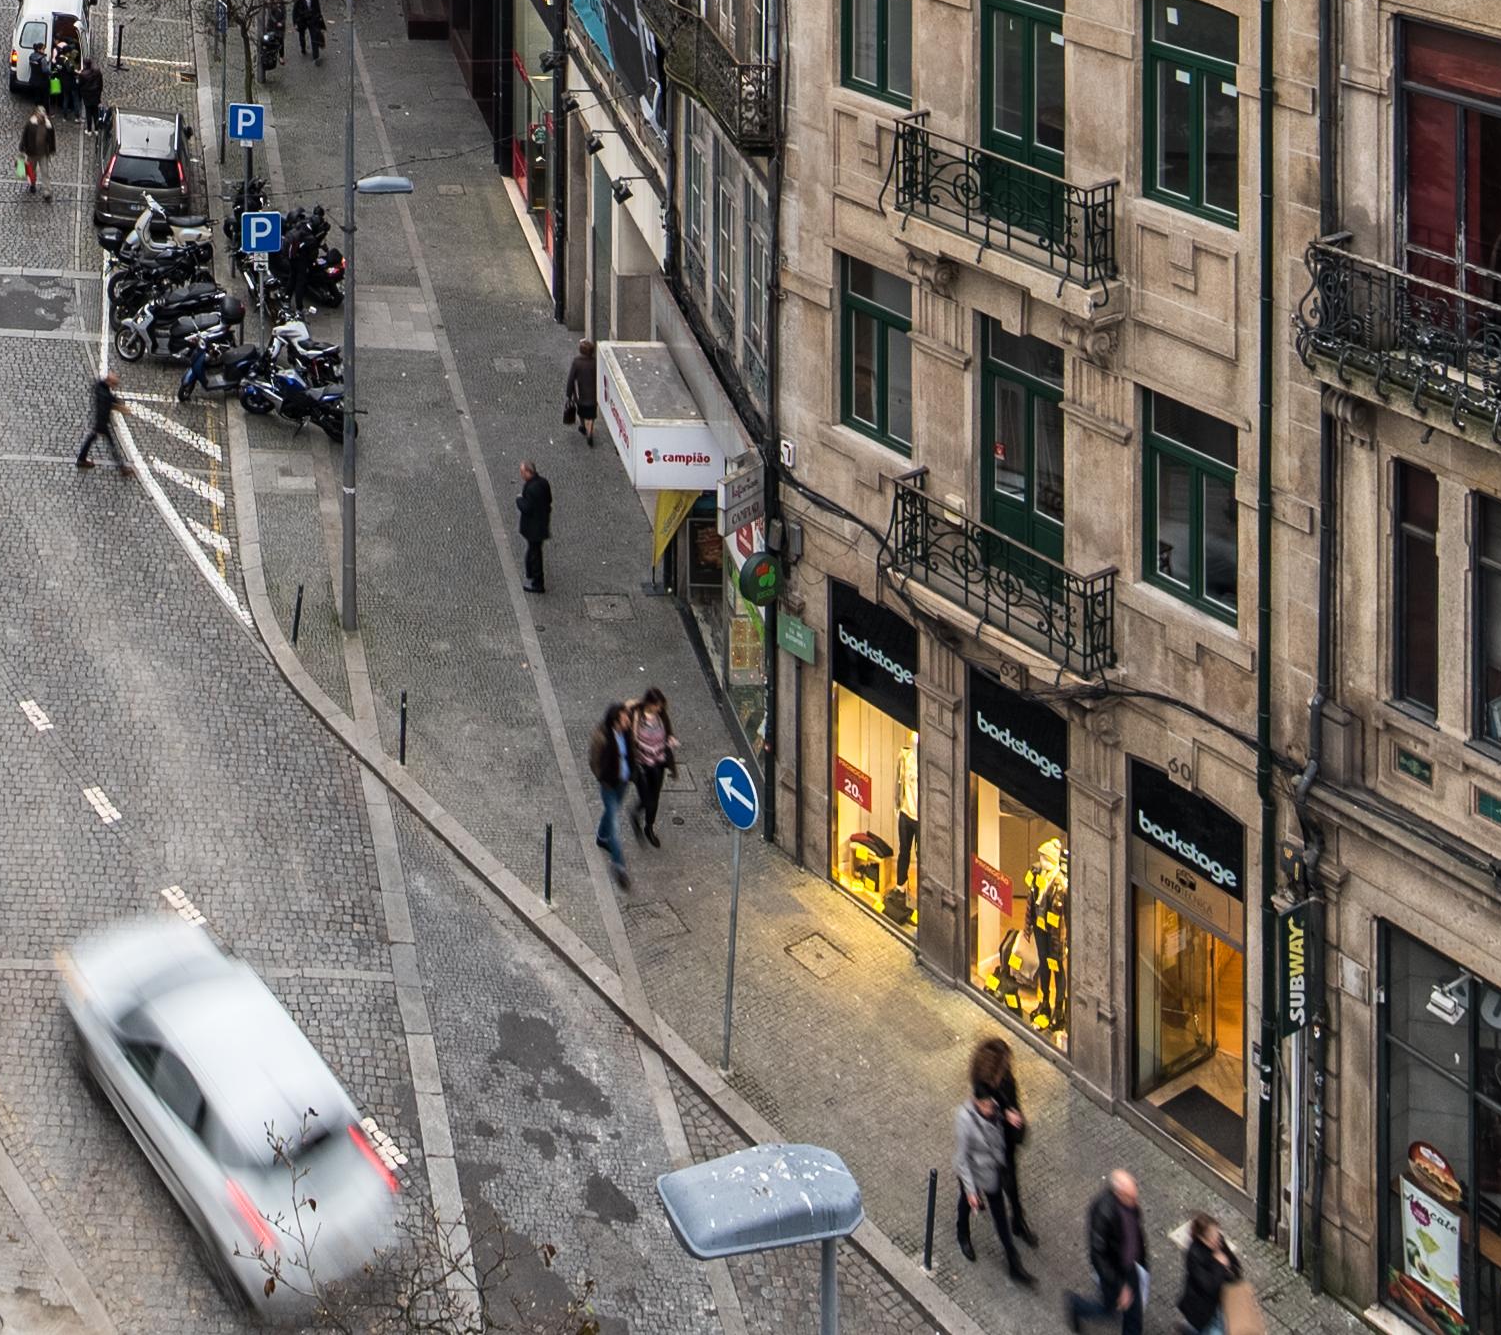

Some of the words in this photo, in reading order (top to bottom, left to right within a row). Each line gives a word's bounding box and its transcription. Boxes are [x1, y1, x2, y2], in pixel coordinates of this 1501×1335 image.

[237, 108, 255, 136] P
[250, 218, 272, 248] P
[662, 452, 711, 466] campião
[839, 624, 913, 685] backstage
[1000, 660, 1019, 680] 62
[977, 711, 1063, 779] backstage
[1169, 756, 1191, 782] 60
[1139, 809, 1238, 887] backstage
[1288, 916, 1306, 1026] SUBWAY
